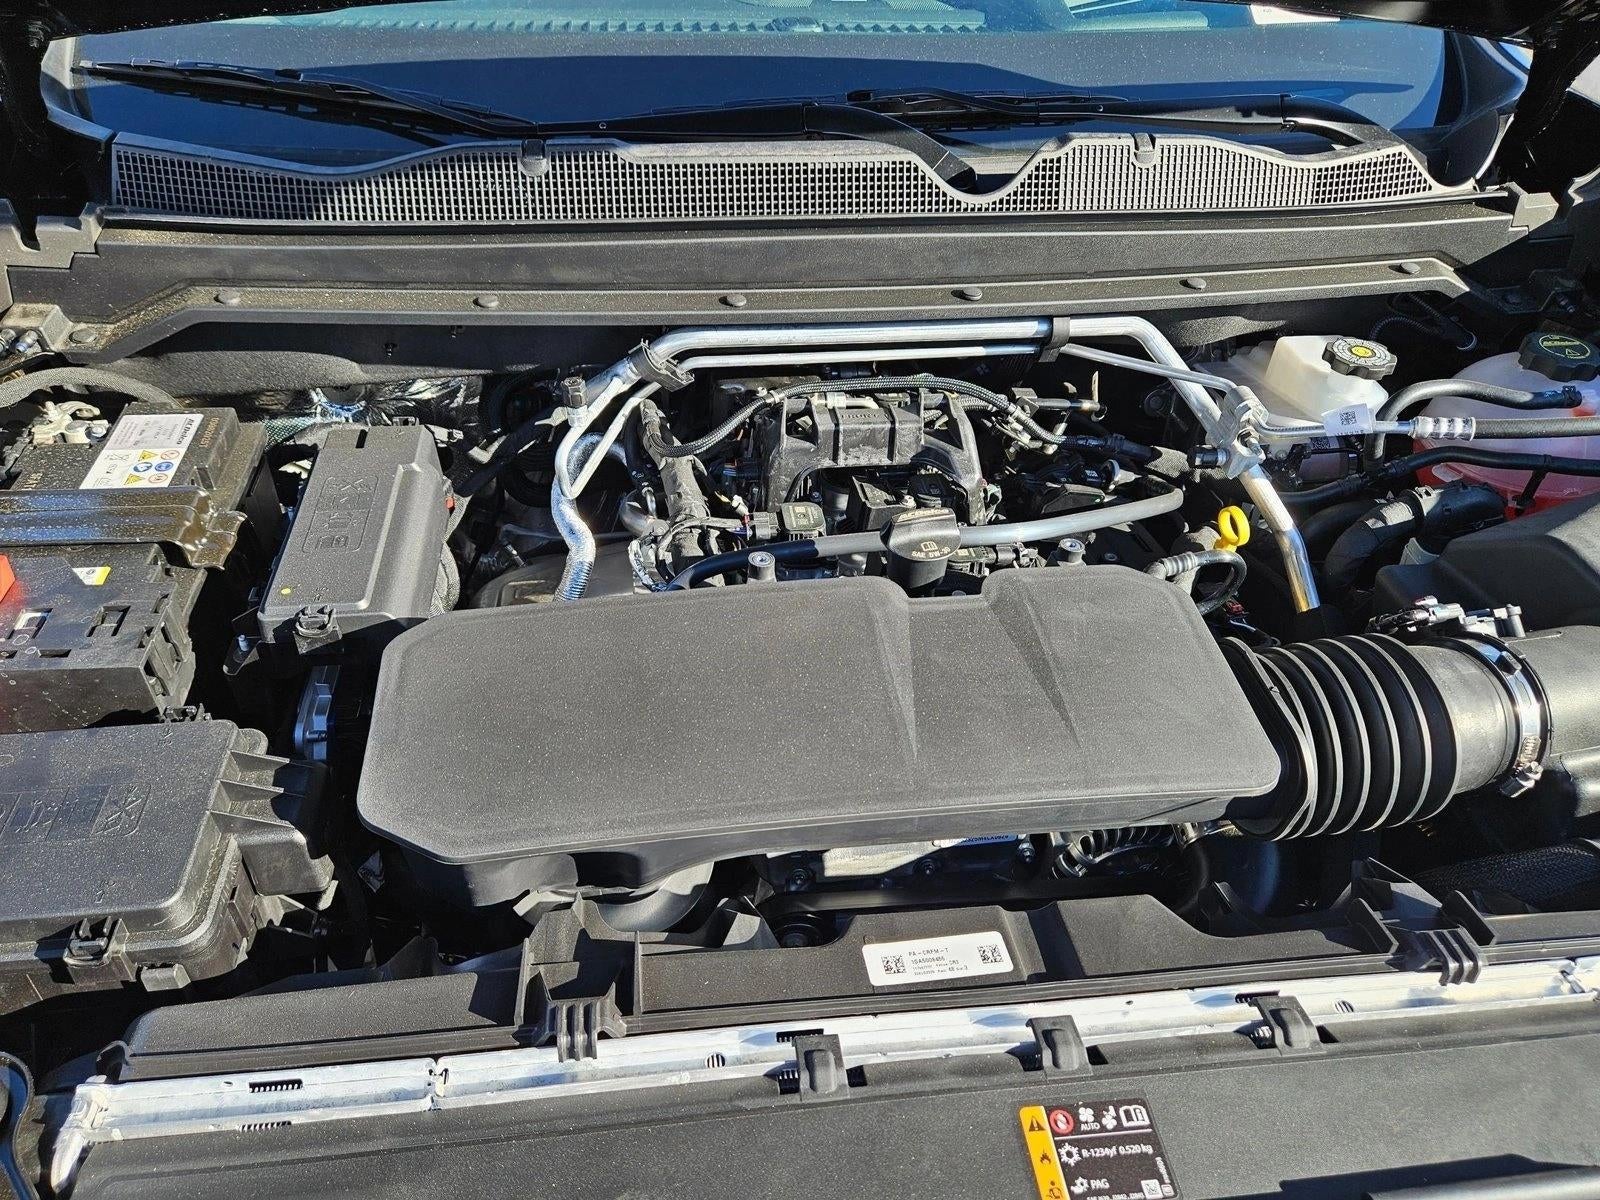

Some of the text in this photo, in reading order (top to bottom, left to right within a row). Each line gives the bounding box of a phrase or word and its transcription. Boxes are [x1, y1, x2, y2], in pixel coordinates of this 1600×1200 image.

[911, 550, 927, 558] SAE
[1080, 1121, 1101, 1132] AUTO
[1081, 1145, 1118, 1159] R-1234yf
[1140, 1143, 1154, 1156] kg
[1089, 1178, 1110, 1190] PAG
